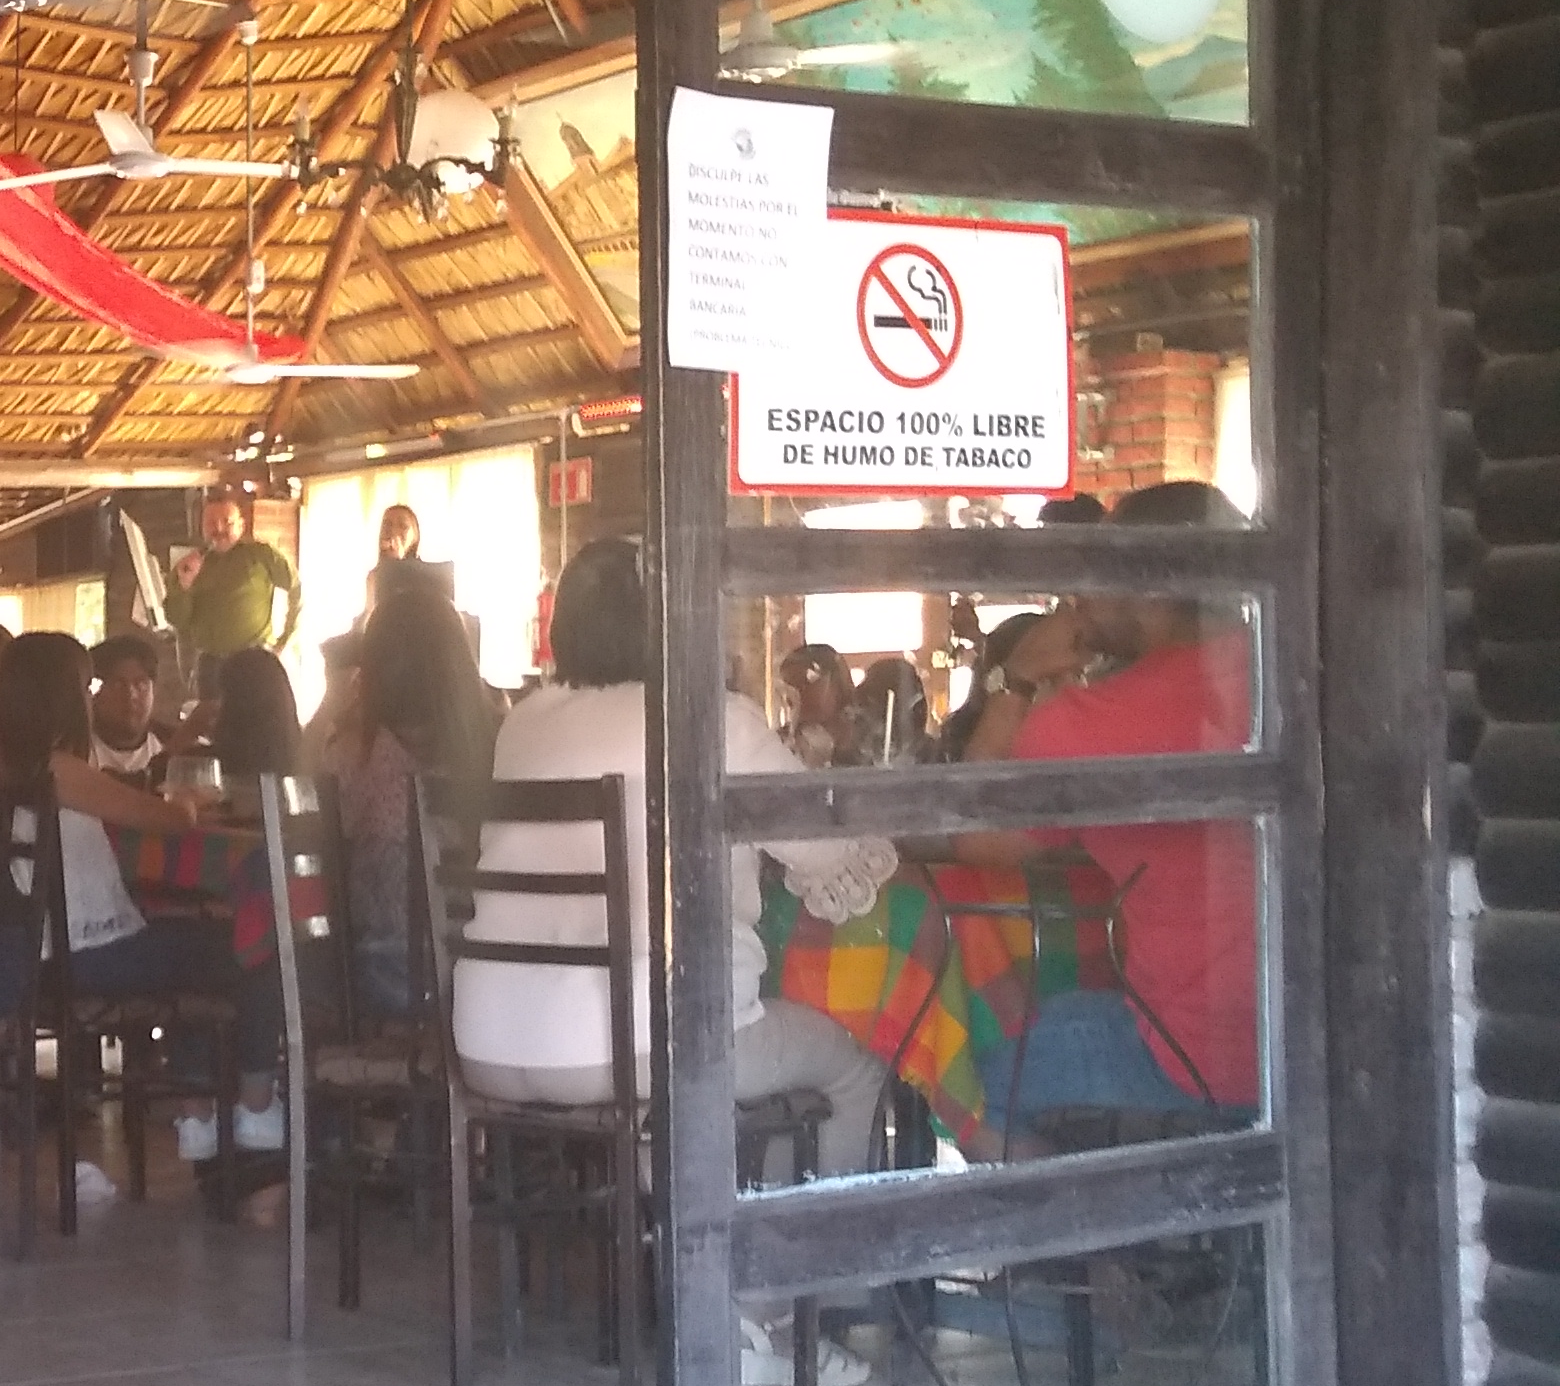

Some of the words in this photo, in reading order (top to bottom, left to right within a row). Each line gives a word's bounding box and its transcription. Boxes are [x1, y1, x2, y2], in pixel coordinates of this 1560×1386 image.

[688, 162, 743, 183] DISCULPE
[747, 170, 770, 187] LAS
[688, 189, 755, 212] MOLESTIAS
[759, 199, 783, 214] POR
[787, 202, 798, 217] EL
[688, 217, 755, 238] MOMENTO
[759, 226, 777, 239] NO
[688, 243, 757, 266] CONTAMOS
[689, 269, 746, 291] TERMINAL
[689, 296, 747, 317] BANCARIA
[766, 408, 886, 435] ESPACIO
[896, 411, 964, 438] 100%
[973, 415, 1047, 439] LIBRE
[783, 444, 815, 466] DE
[823, 445, 896, 468] HUMO
[904, 446, 934, 468] DE
[942, 447, 1033, 470] TABACO
